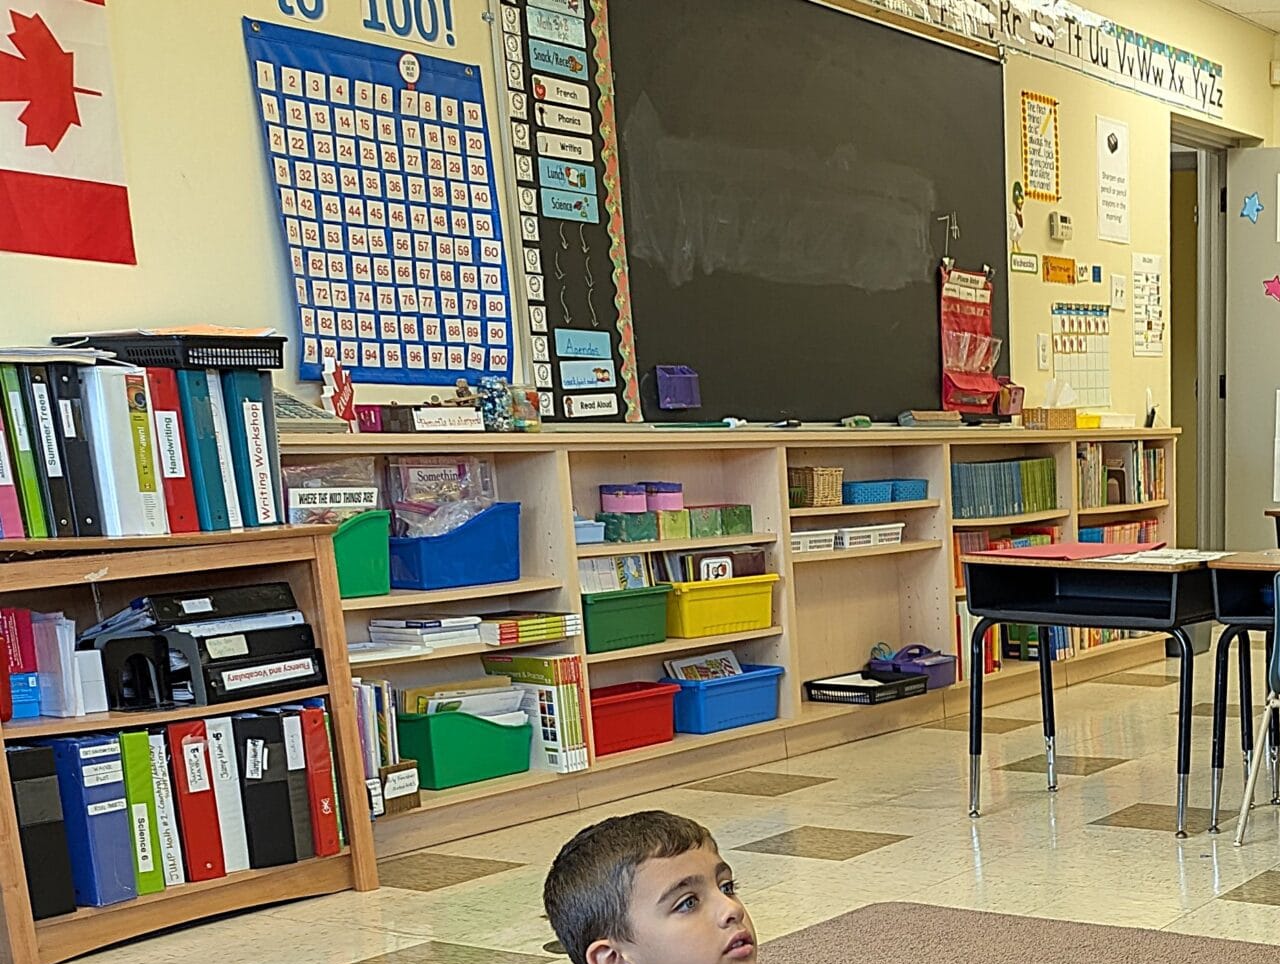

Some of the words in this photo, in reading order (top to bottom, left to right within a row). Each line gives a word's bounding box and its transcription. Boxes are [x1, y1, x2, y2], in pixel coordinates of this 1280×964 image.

[1064, 13, 1081, 57] Tt
[1089, 26, 1108, 67] Uu
[1116, 38, 1134, 77] Vv
[1137, 46, 1164, 87] Ww
[1169, 57, 1184, 94] Xx
[1192, 67, 1207, 108] Yy
[264, 70, 268, 82] 1
[288, 75, 296, 88] 2
[312, 80, 320, 92] 3
[336, 85, 343, 96] 4
[360, 88, 368, 100] 5
[380, 93, 388, 105] 6
[406, 97, 413, 109] 7
[424, 101, 432, 112] 8
[446, 105, 453, 117] 9
[468, 109, 479, 121] 10
[556, 87, 577, 100] French
[1209, 74, 1223, 107] Zz
[558, 114, 581, 125] Phonics
[560, 143, 582, 155] Writing
[299, 169, 312, 182] 32
[321, 172, 334, 184] 33
[344, 174, 357, 188] 34
[366, 177, 378, 190] 35
[389, 180, 402, 192] 36
[411, 183, 422, 195] 37
[432, 186, 444, 198] 38
[454, 188, 466, 201] 39
[474, 192, 488, 203] 40
[547, 166, 564, 180] Lunch
[551, 197, 572, 211] Science
[305, 228, 317, 242] 52
[328, 231, 340, 244] 53
[352, 234, 364, 246] 54
[371, 236, 384, 247] 55
[396, 238, 409, 251] 56
[418, 240, 429, 252] 57
[440, 243, 451, 255] 58
[457, 244, 470, 256] 59
[484, 246, 498, 258] 60
[324, 346, 336, 358] 92
[344, 348, 355, 360] 93
[364, 349, 377, 360] 94
[386, 350, 399, 362] 95
[409, 351, 422, 362] 96
[432, 352, 443, 363] 97
[450, 353, 462, 364] 98
[470, 352, 482, 364] 99
[491, 355, 506, 366] 100
[38, 394, 48, 422] Trees
[581, 401, 595, 409] Read
[597, 400, 612, 408] Aloud
[43, 424, 57, 467] Summer
[163, 416, 178, 475] Handwriting
[250, 403, 266, 468] Workshop
[416, 470, 458, 482] Somethin
[254, 471, 271, 522] Writing
[298, 493, 317, 504] WHERE
[319, 493, 328, 504] THE
[329, 493, 341, 503] WILD
[343, 492, 362, 503] THINGS
[363, 492, 374, 502] ARE
[228, 670, 267, 683] Vocabulary
[269, 666, 281, 675] and
[284, 662, 310, 673] Fluency
[136, 817, 148, 849] Science
[140, 852, 148, 861] 6
[167, 853, 179, 880] JUMP
